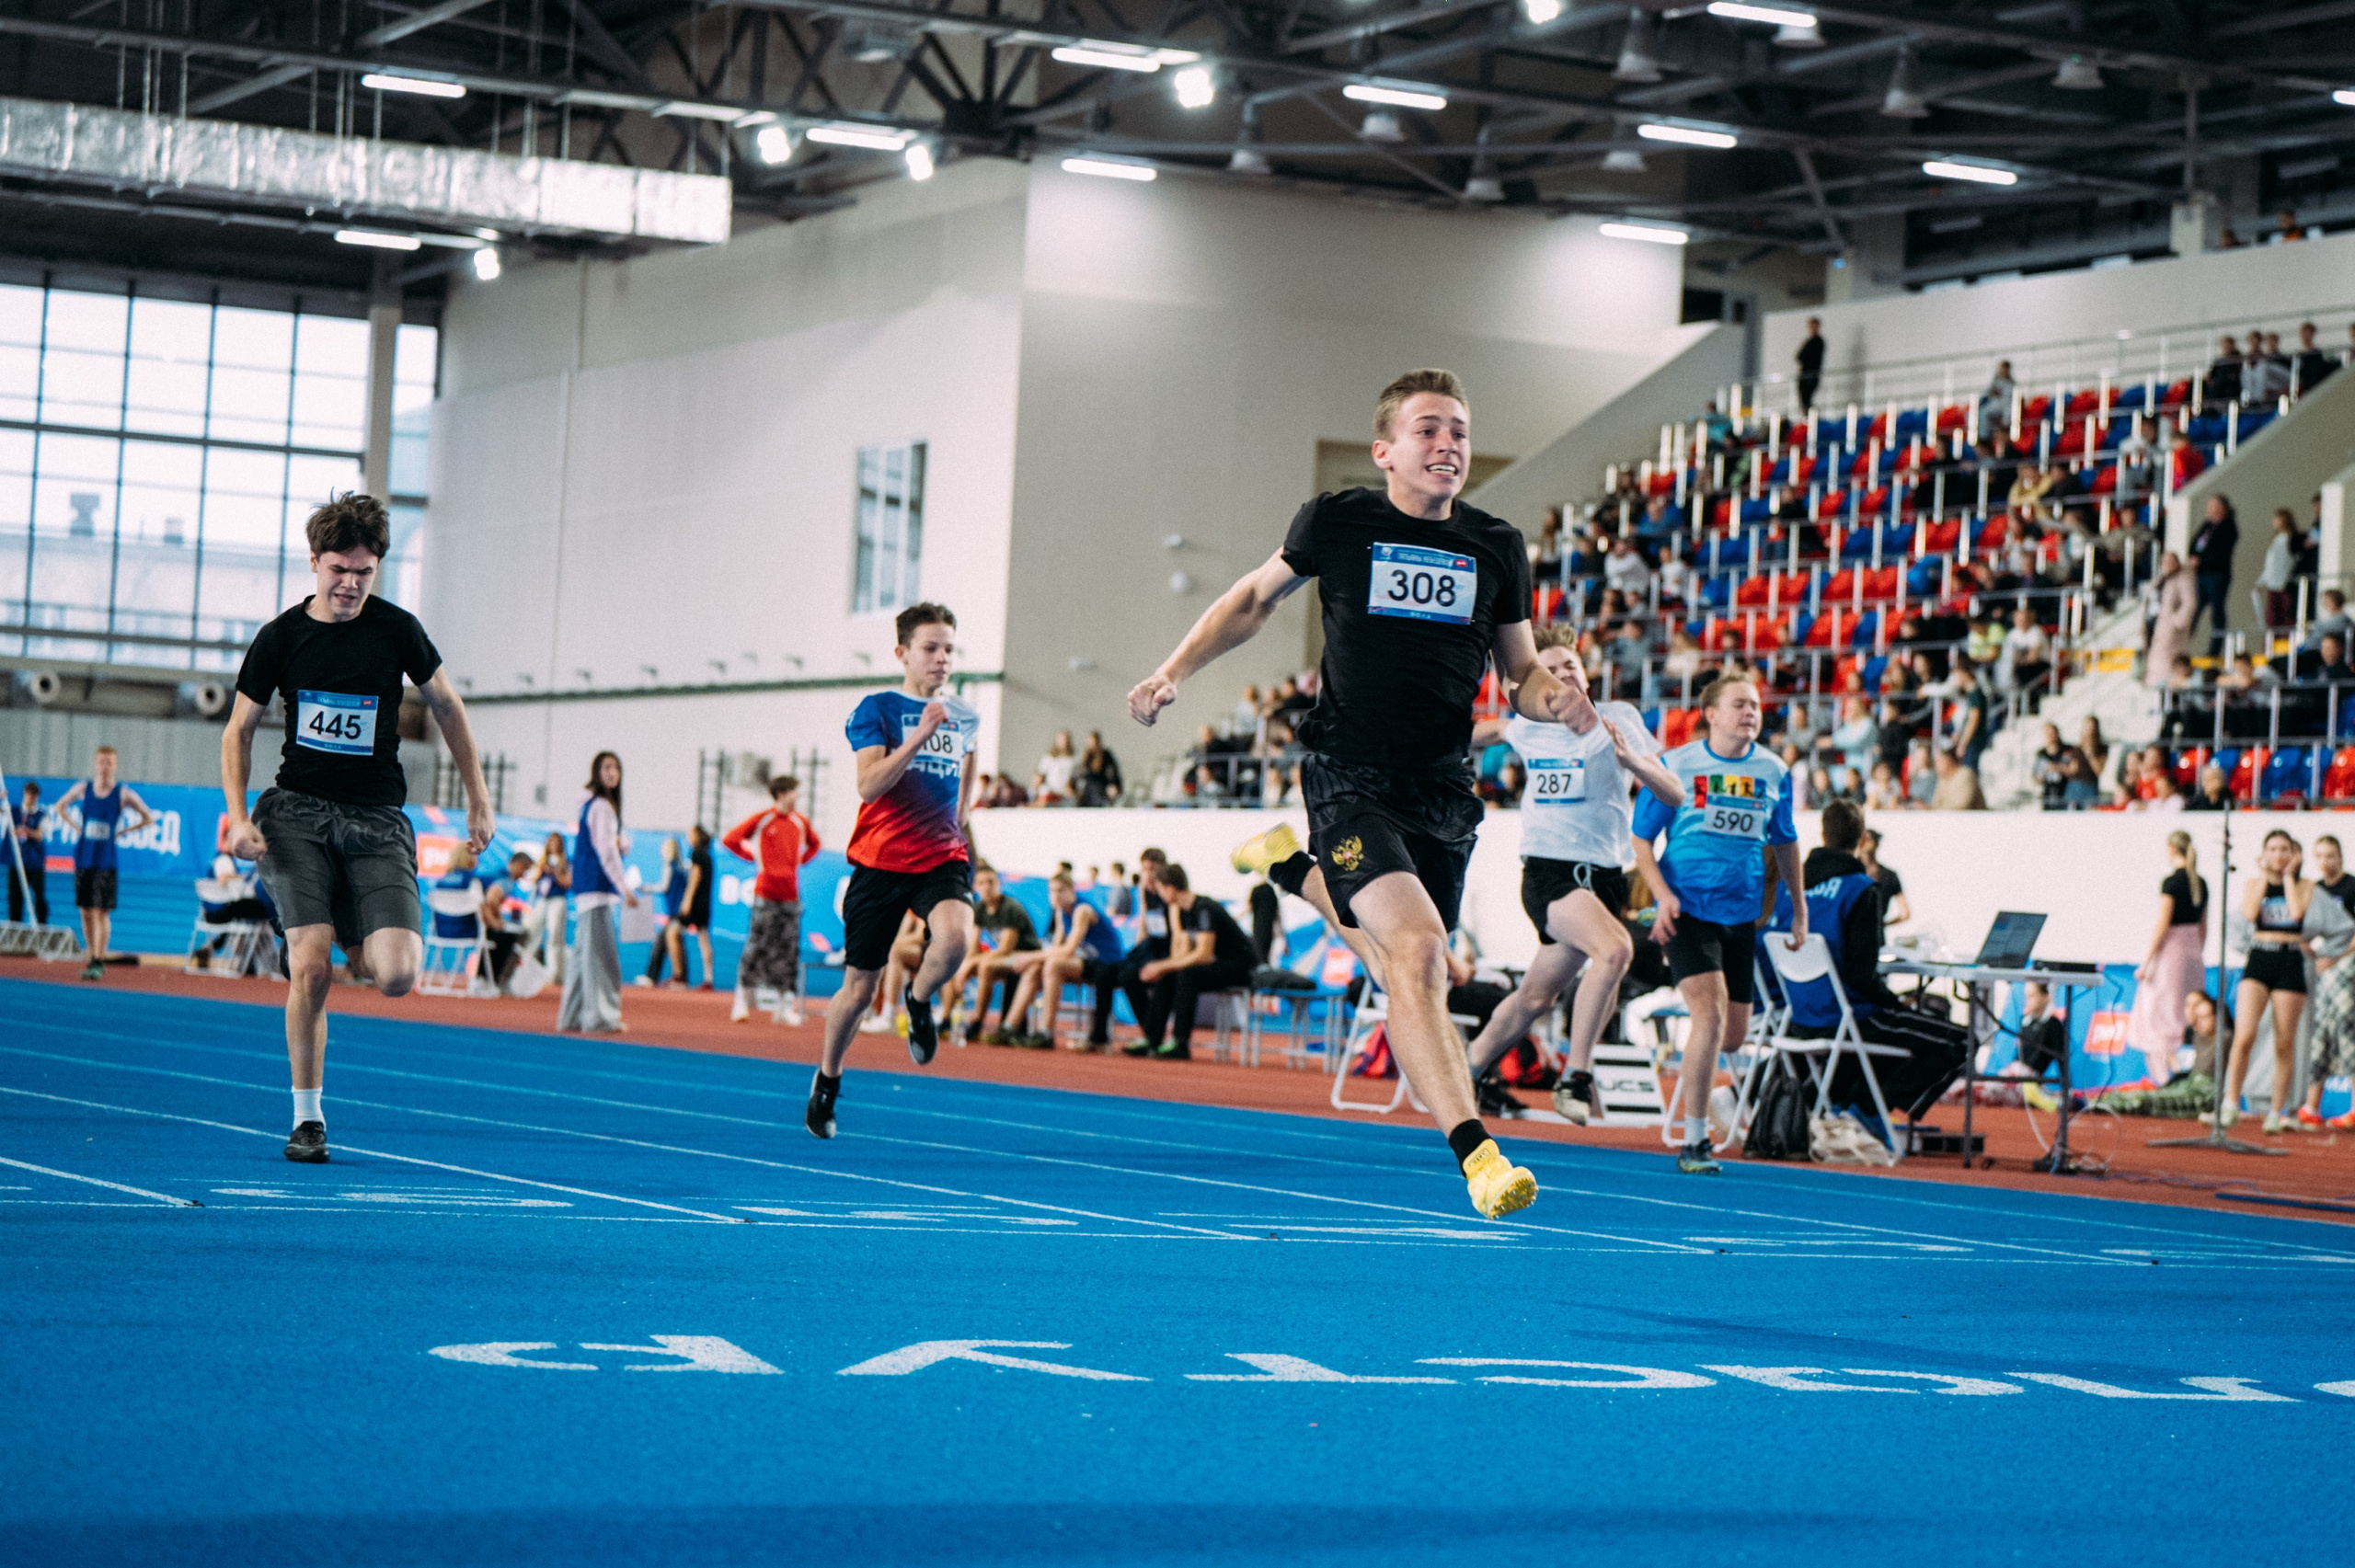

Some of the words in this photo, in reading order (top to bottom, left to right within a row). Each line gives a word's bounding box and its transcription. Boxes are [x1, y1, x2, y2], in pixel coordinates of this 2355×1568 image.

[1388, 569, 1456, 607] 308
[309, 711, 362, 739] 445
[1537, 773, 1571, 794] 287
[1713, 810, 1753, 832] 590
[427, 1334, 2355, 1402] ластур
